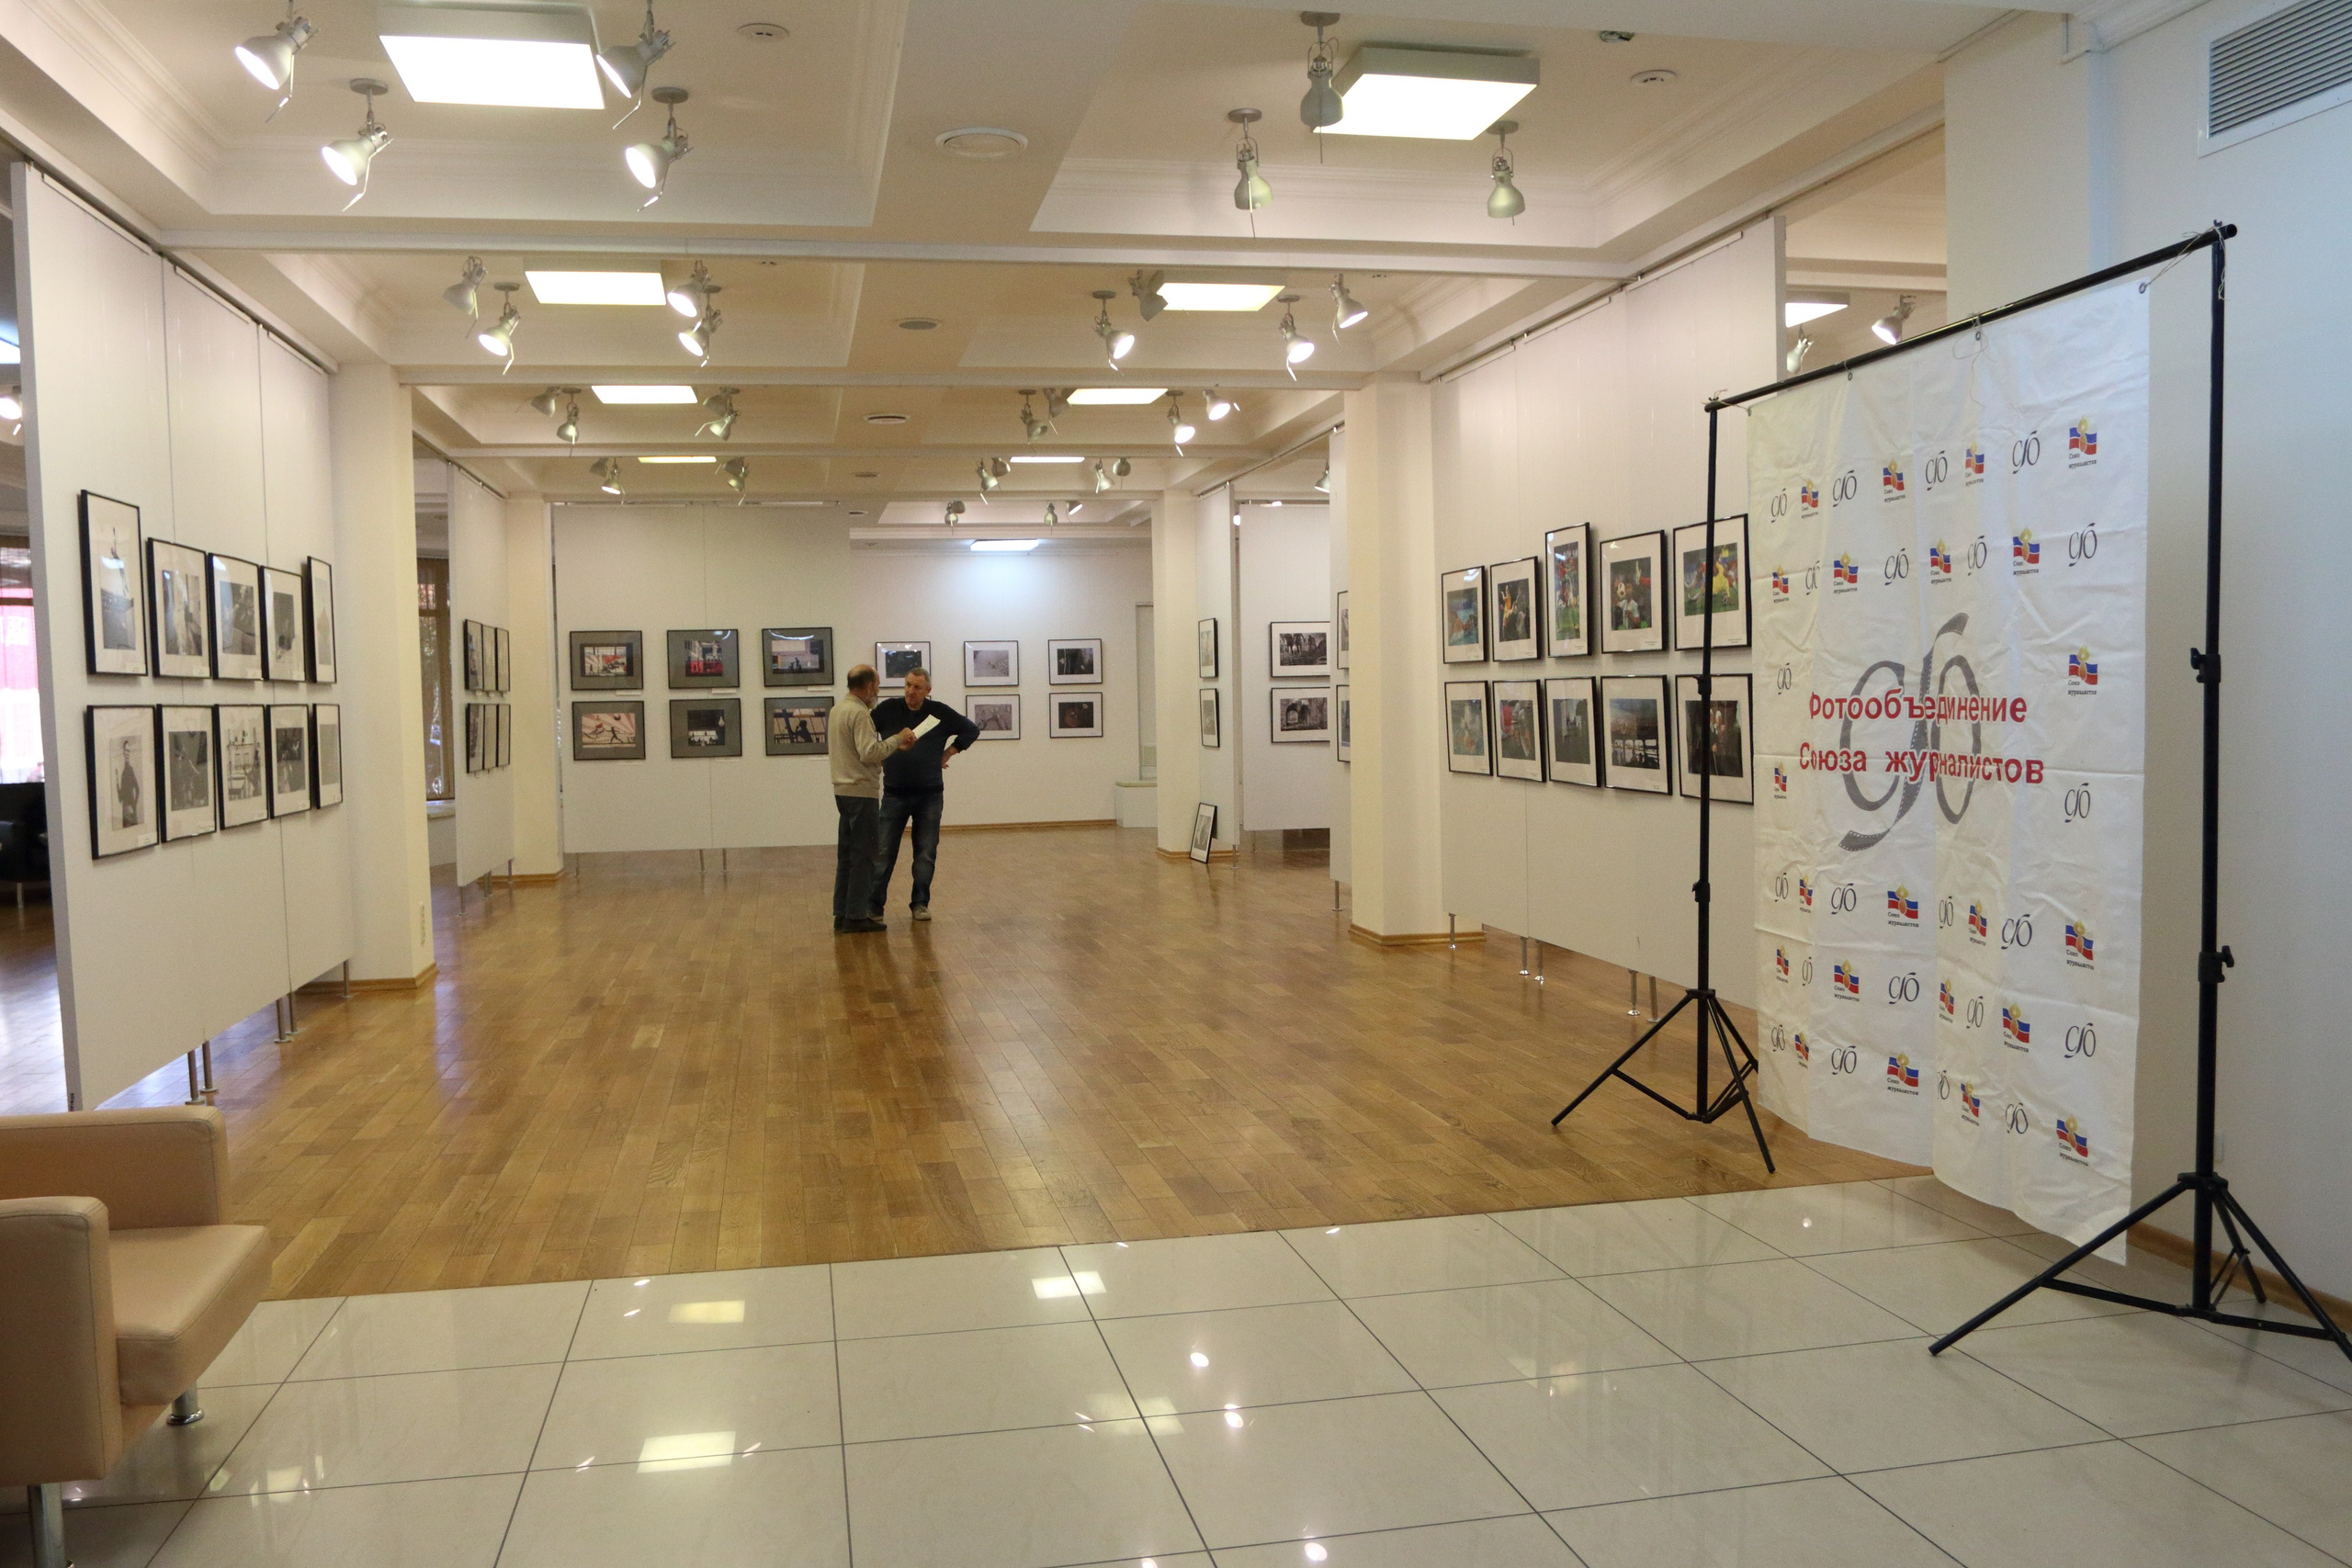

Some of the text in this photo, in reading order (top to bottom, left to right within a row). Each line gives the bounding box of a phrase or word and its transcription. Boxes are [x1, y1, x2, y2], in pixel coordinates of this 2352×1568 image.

[1810, 687, 2028, 725] Фотообъединение
[1799, 741, 2045, 784] Союза журналистов
